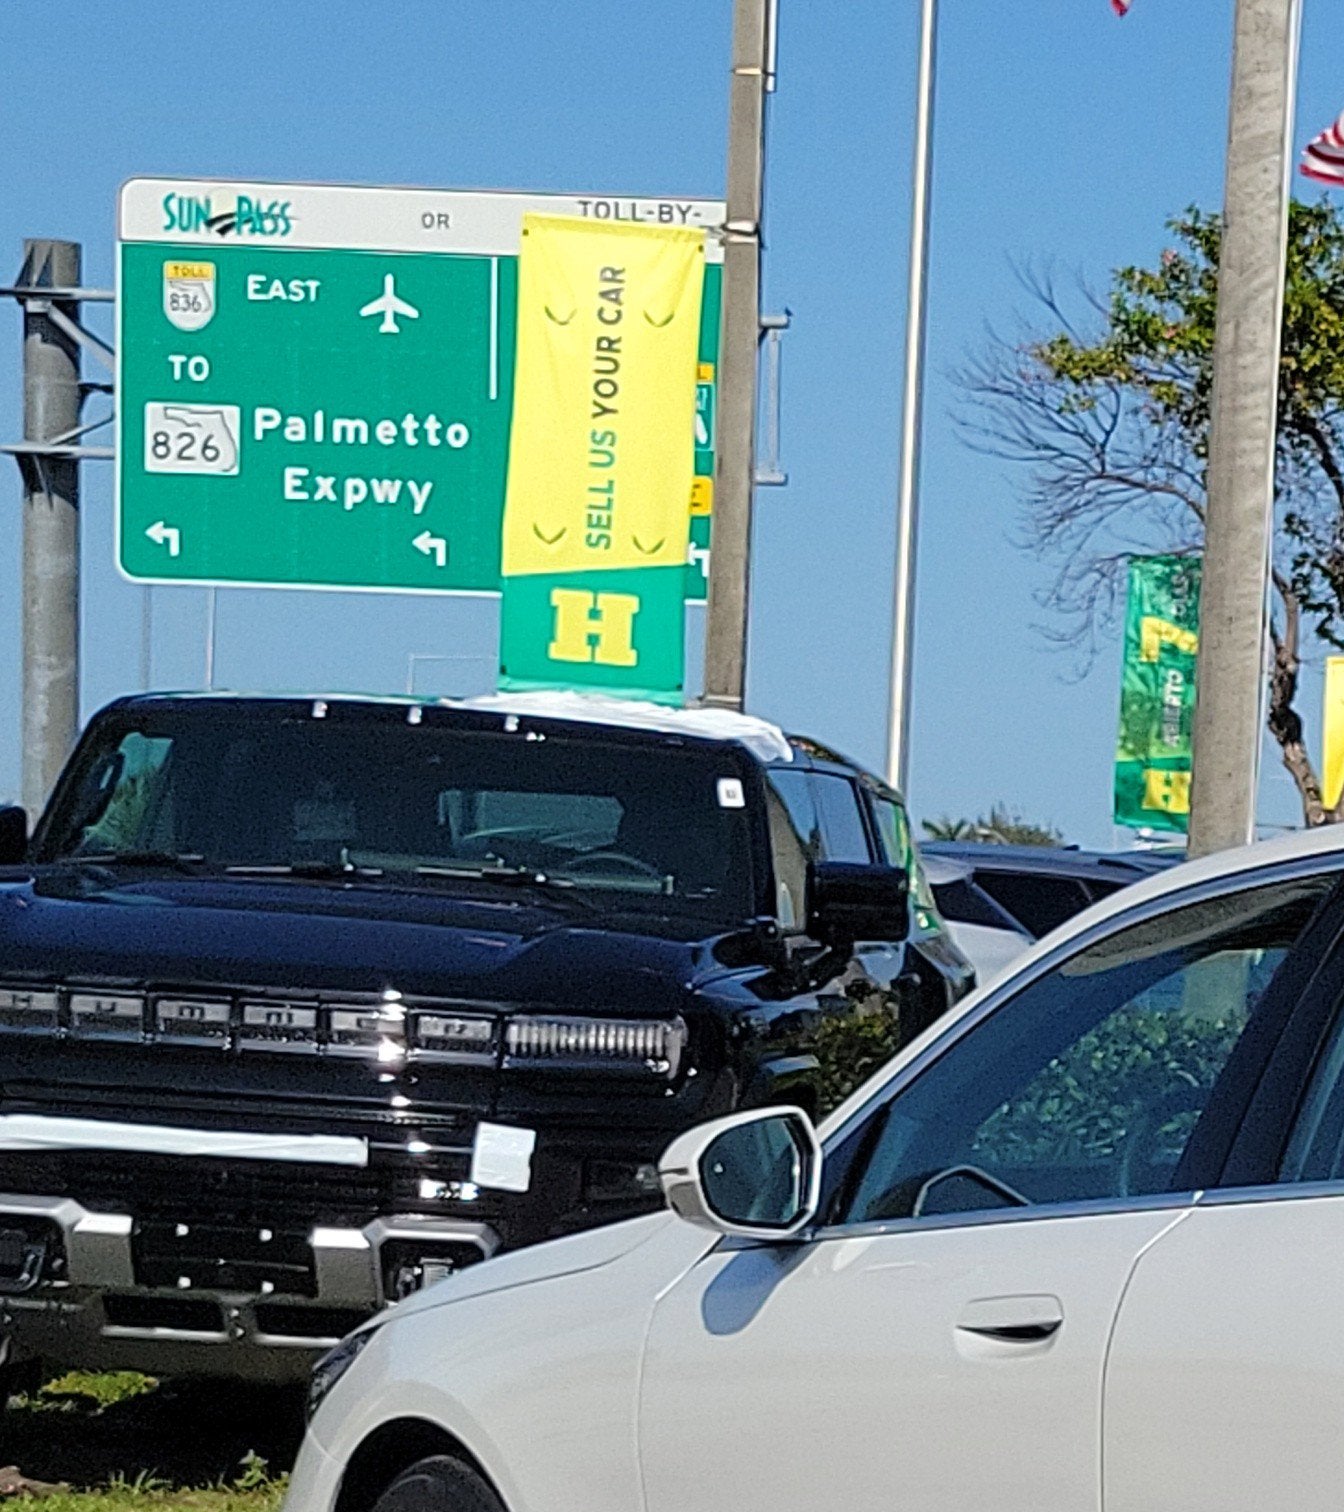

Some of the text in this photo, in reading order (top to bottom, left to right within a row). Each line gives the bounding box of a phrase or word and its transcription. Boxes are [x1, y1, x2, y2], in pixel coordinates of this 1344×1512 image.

[420, 211, 450, 230] OR
[172, 264, 209, 278] TOLL
[169, 292, 202, 313] 836
[247, 273, 321, 302] EAST
[168, 355, 210, 382] TO
[585, 266, 627, 550] SELL US YOUR CAR
[254, 406, 470, 449] Palmetto
[151, 431, 221, 463] 826
[283, 466, 434, 515] Expwy
[549, 588, 640, 667] H
